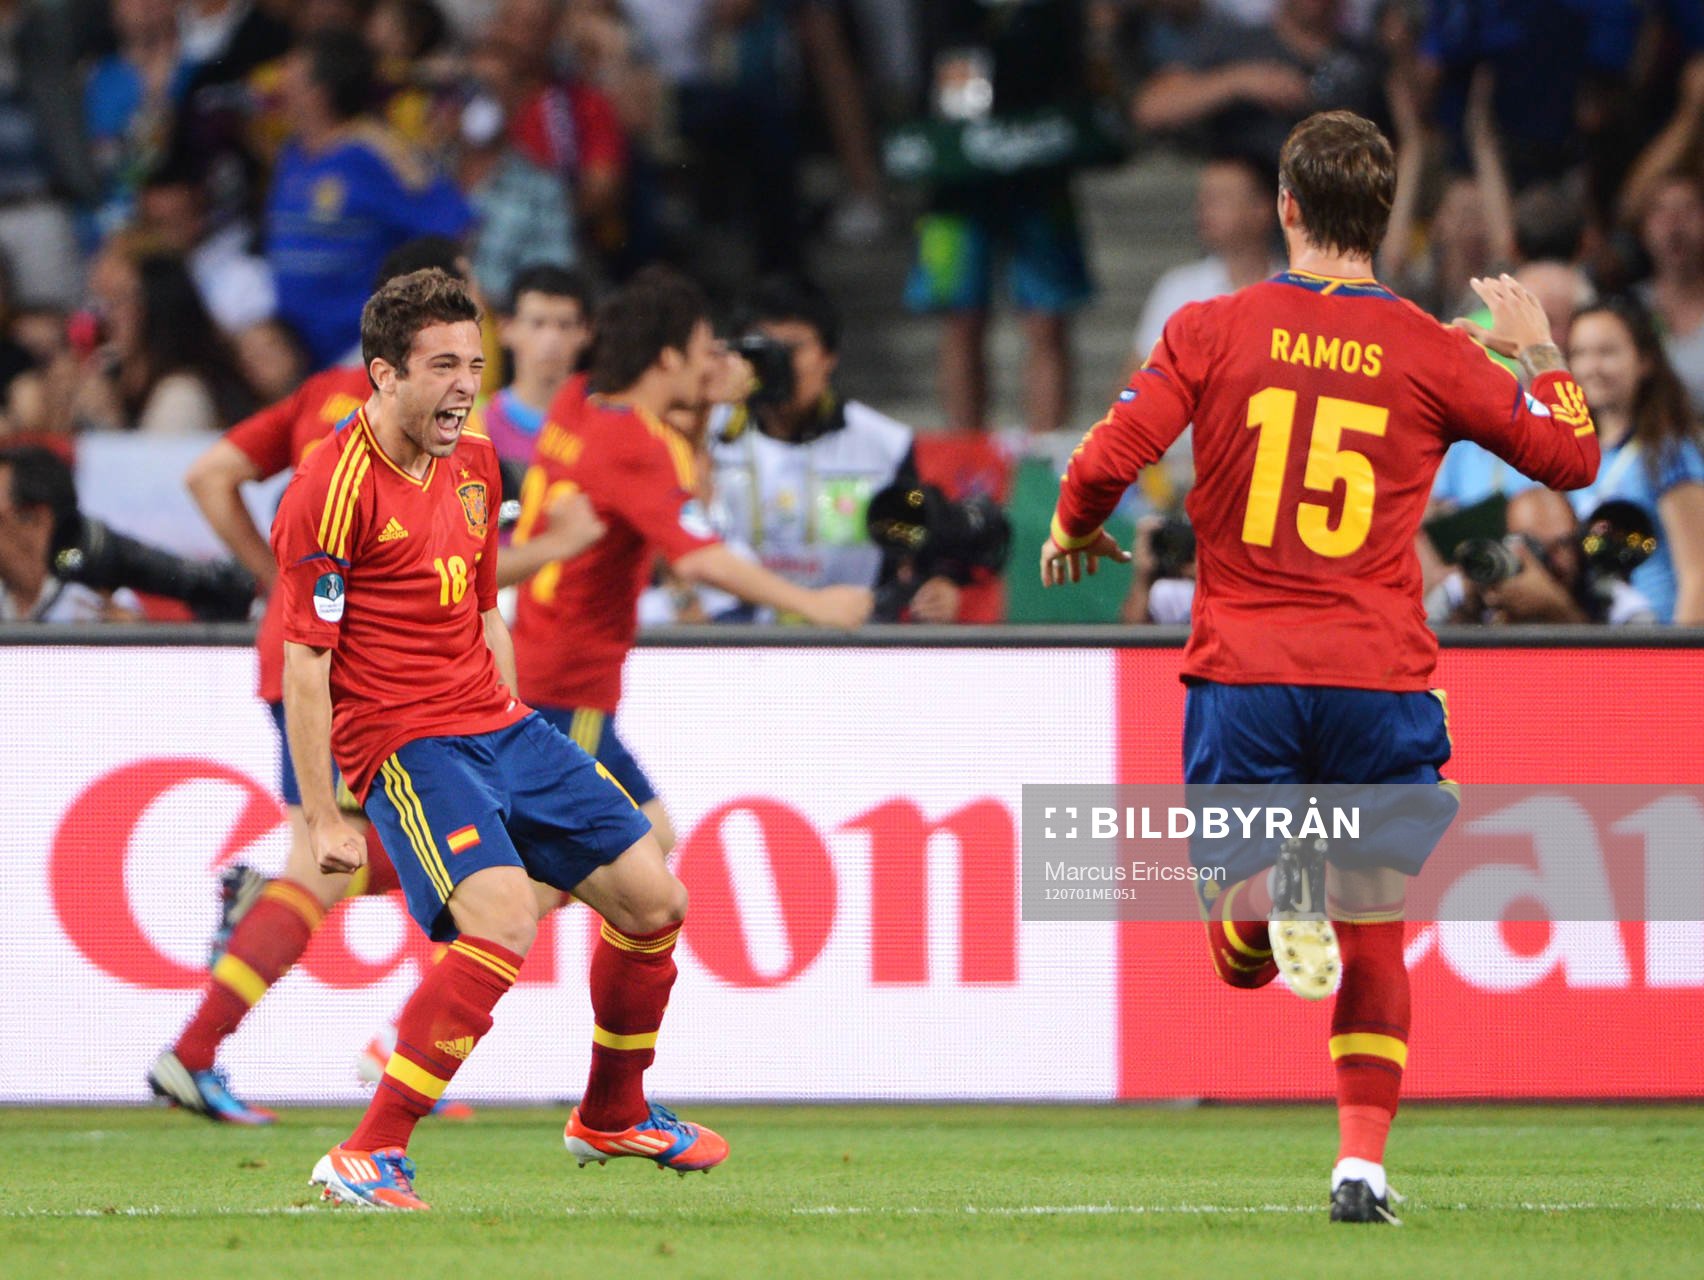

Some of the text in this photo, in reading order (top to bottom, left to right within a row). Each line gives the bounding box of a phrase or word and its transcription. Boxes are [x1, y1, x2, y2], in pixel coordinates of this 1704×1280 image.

[1270, 327, 1384, 378] RAMOS
[1241, 386, 1390, 558] 15
[377, 529, 409, 543] adidas
[433, 555, 468, 606] 18
